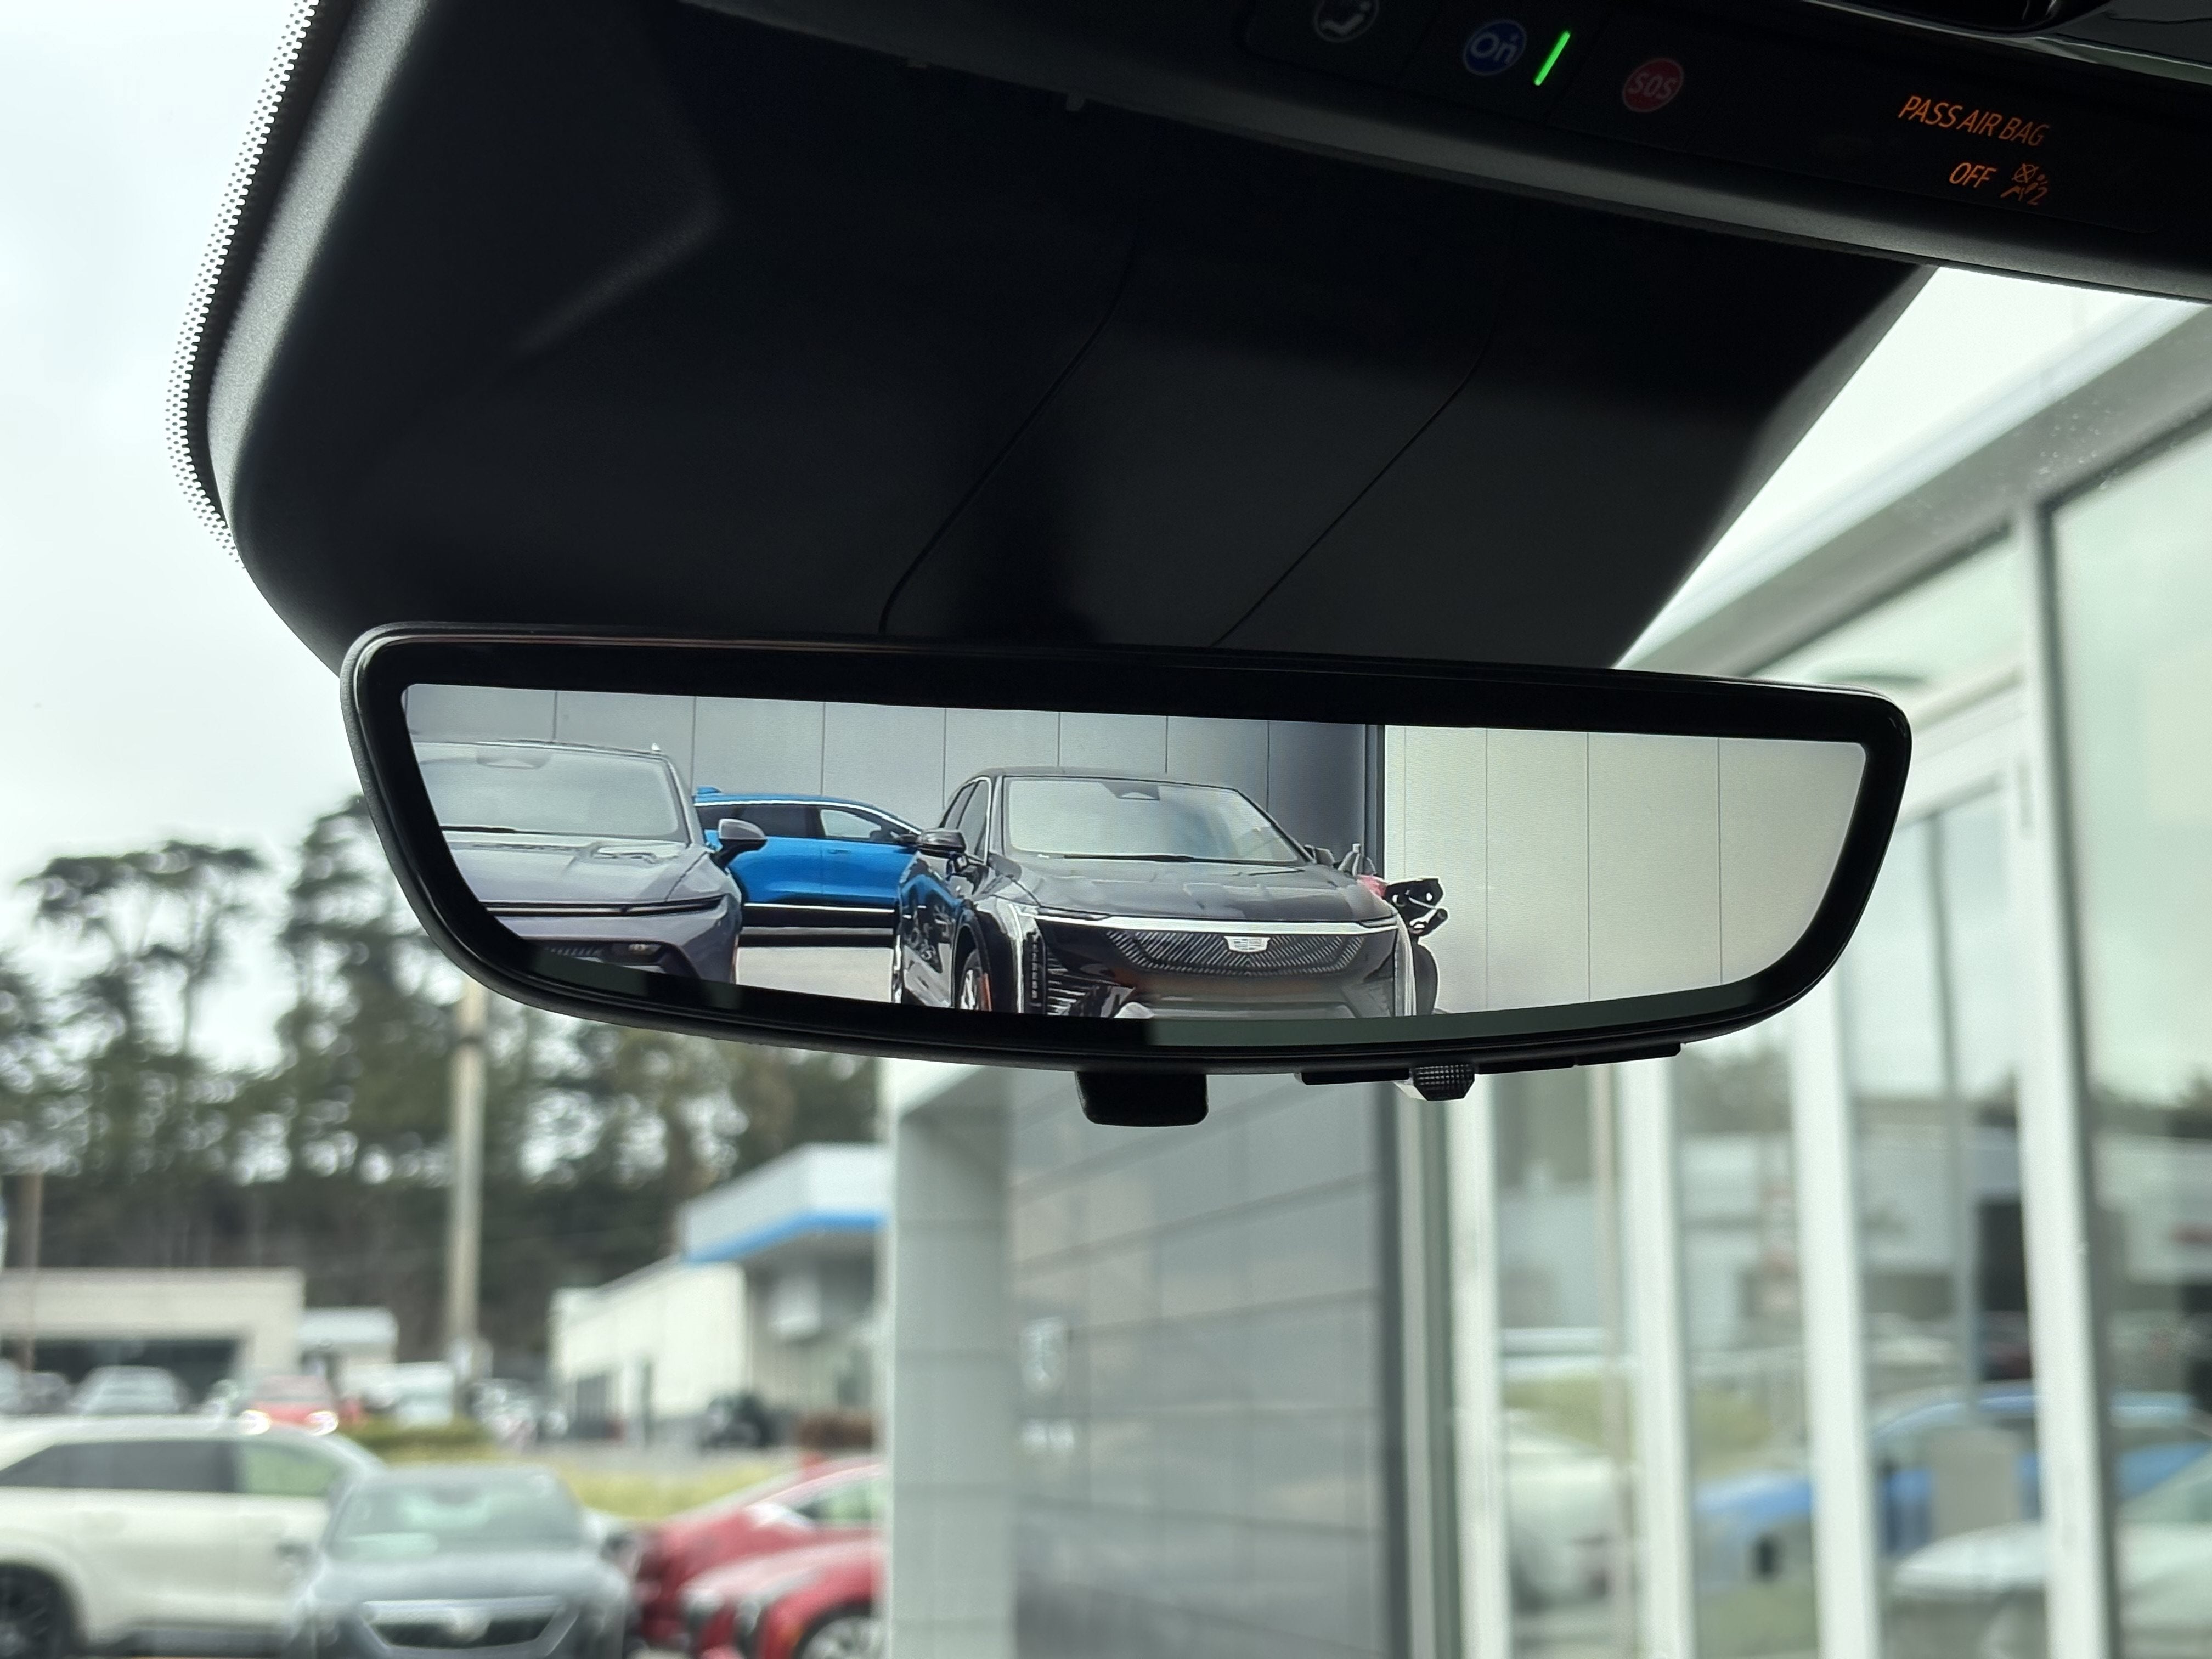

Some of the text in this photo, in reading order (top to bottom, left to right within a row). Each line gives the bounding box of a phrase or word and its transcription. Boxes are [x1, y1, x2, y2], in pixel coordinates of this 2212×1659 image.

[1470, 32, 1517, 63] On
[1628, 72, 1677, 100] SOS
[1898, 95, 2050, 146] PASS AIR BAG
[1949, 162, 1997, 188] OFF
